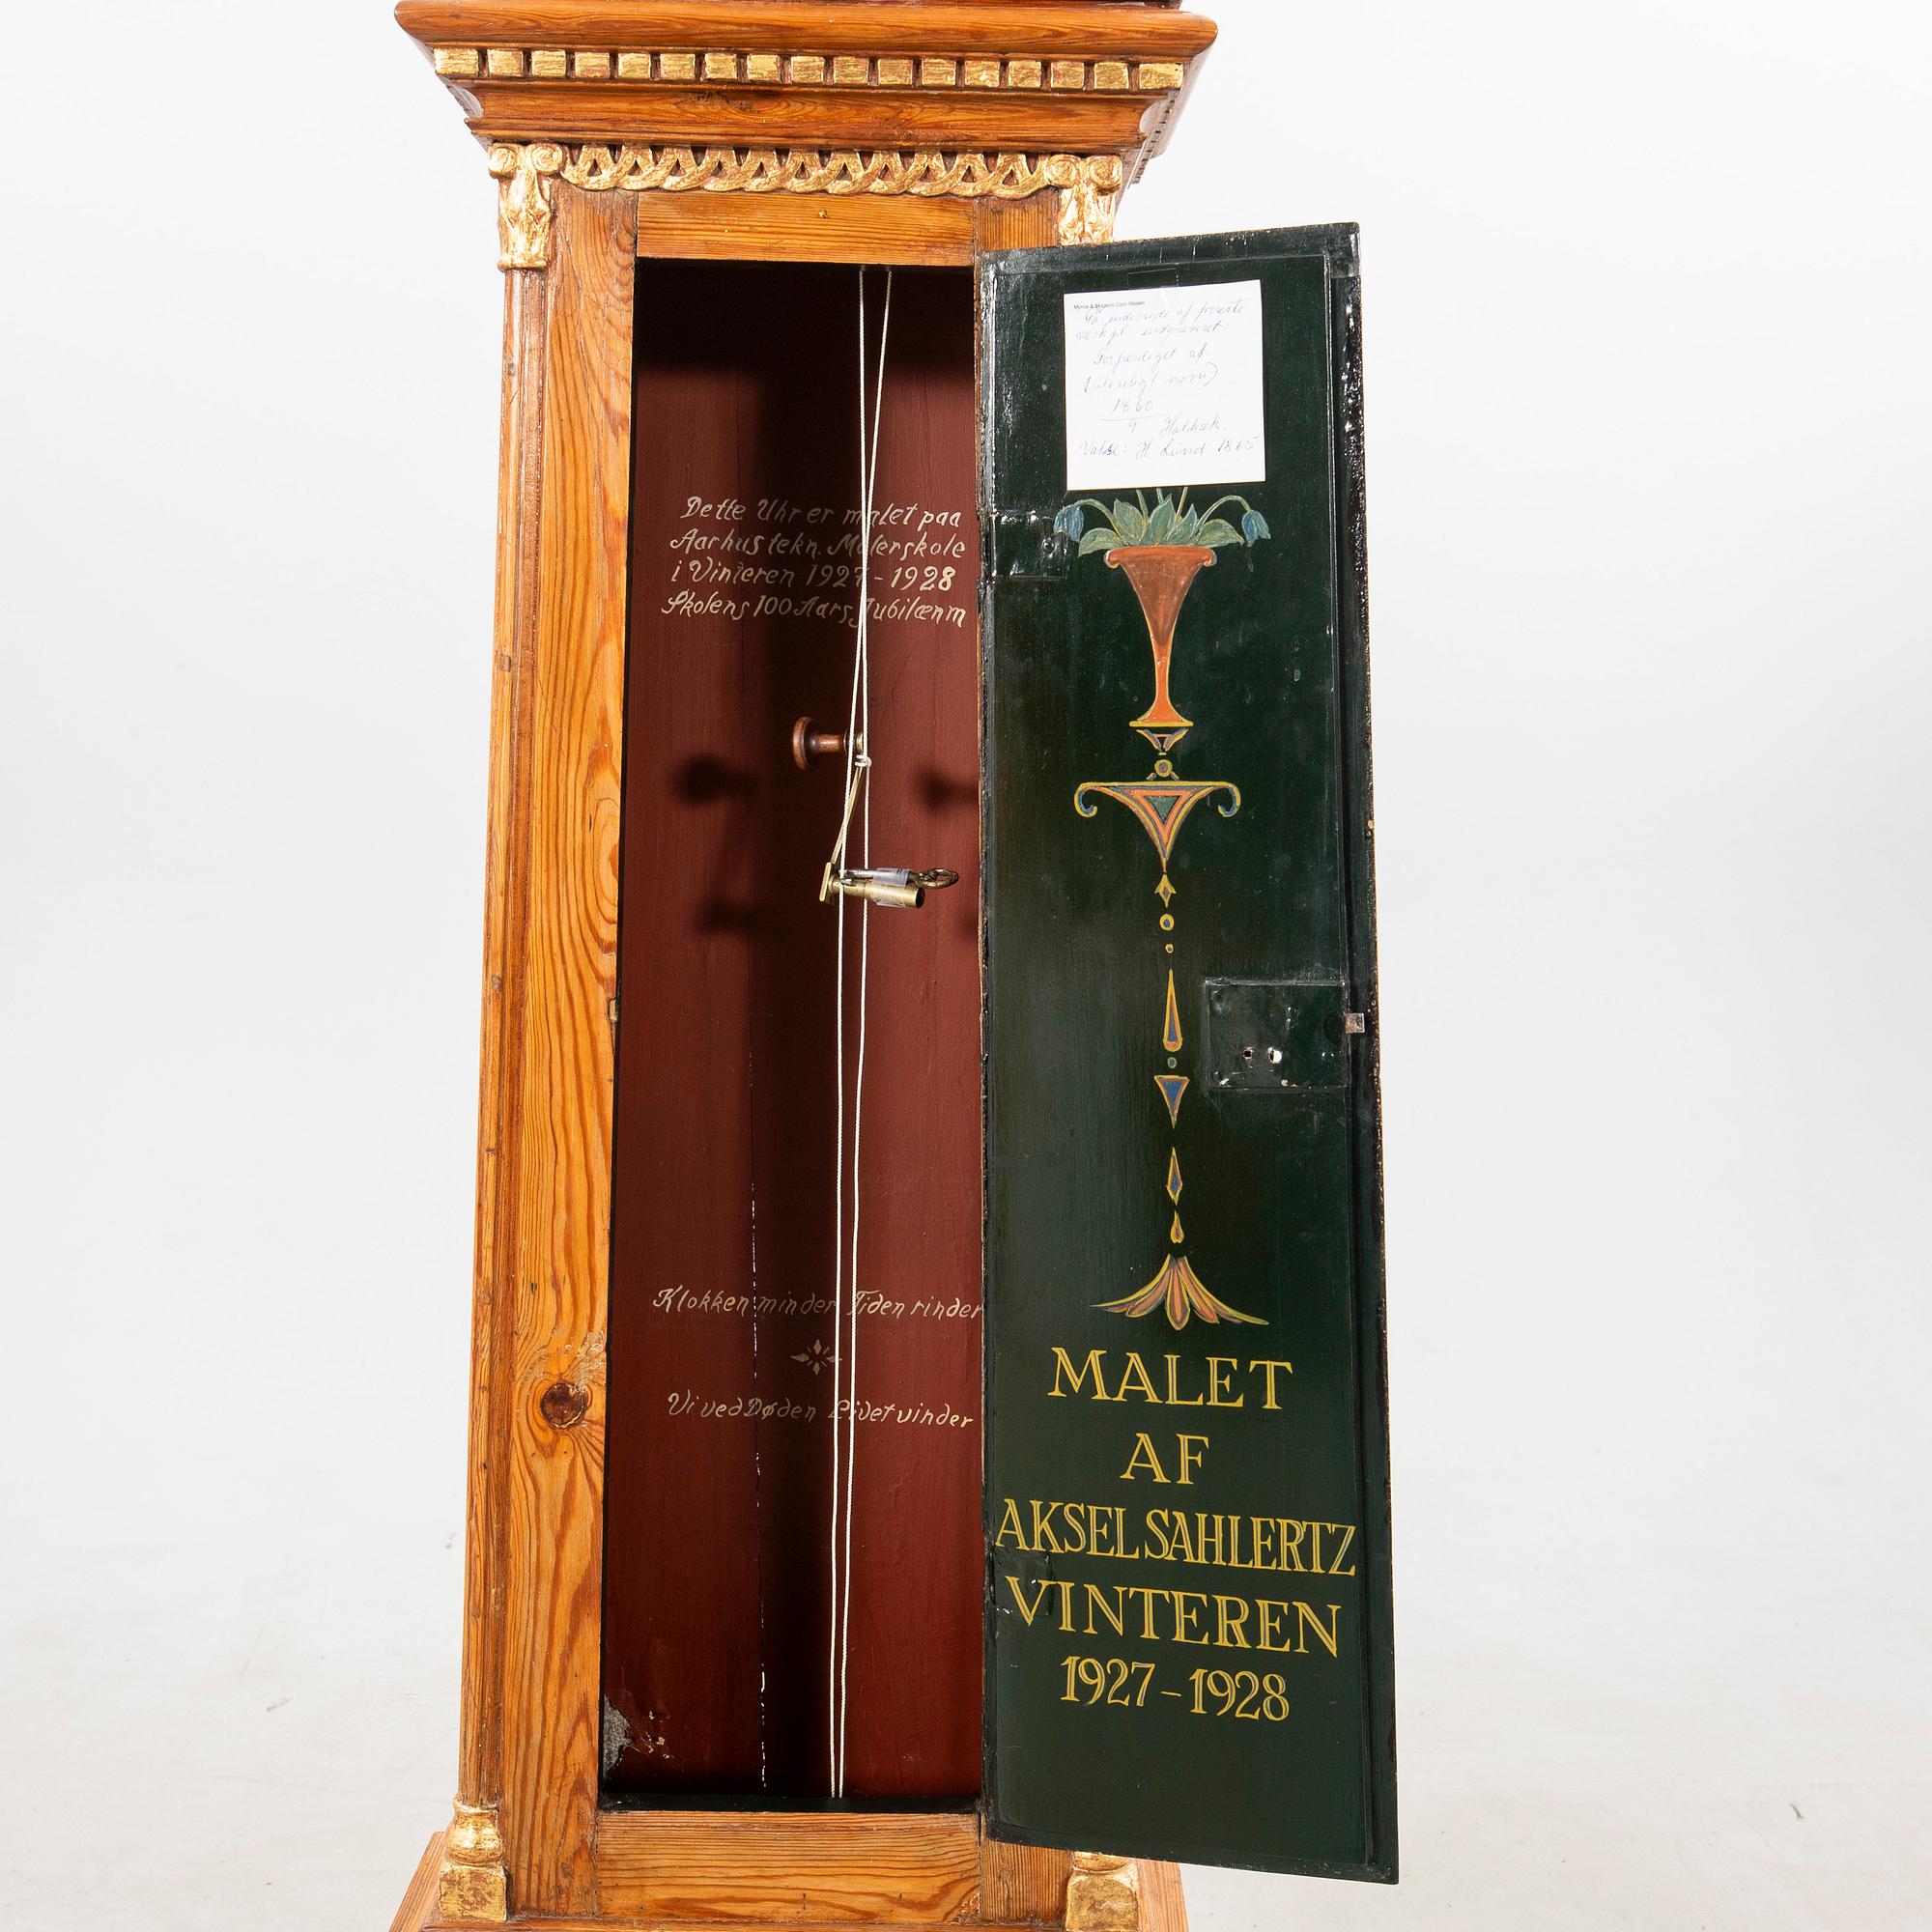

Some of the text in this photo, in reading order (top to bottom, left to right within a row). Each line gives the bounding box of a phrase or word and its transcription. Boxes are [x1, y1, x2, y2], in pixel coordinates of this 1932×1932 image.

[680, 496, 746, 521] Dette
[757, 498, 802, 526] Uhr
[807, 507, 835, 526] er
[917, 509, 962, 531] paa
[669, 527, 766, 556] Aarhus
[768, 532, 822, 559] tekn.
[670, 560, 683, 583] i
[891, 566, 956, 592] 1928
[661, 588, 751, 621] Skolens
[753, 594, 793, 618] 100
[652, 1284, 983, 1321] Klokken minder Tiden rinder
[1047, 1346, 1294, 1410] MALET
[668, 1389, 700, 1416] Vi
[700, 1397, 744, 1419] ved
[743, 1397, 817, 1423] Døden
[895, 1401, 975, 1429] vinder
[1119, 1433, 1209, 1486] AF
[994, 1498, 1357, 1577] AKSEL SAHLERTZ
[1004, 1575, 1343, 1659] VINTEREN
[1060, 1655, 1156, 1708] 1927
[1189, 1667, 1291, 1721] 1928
